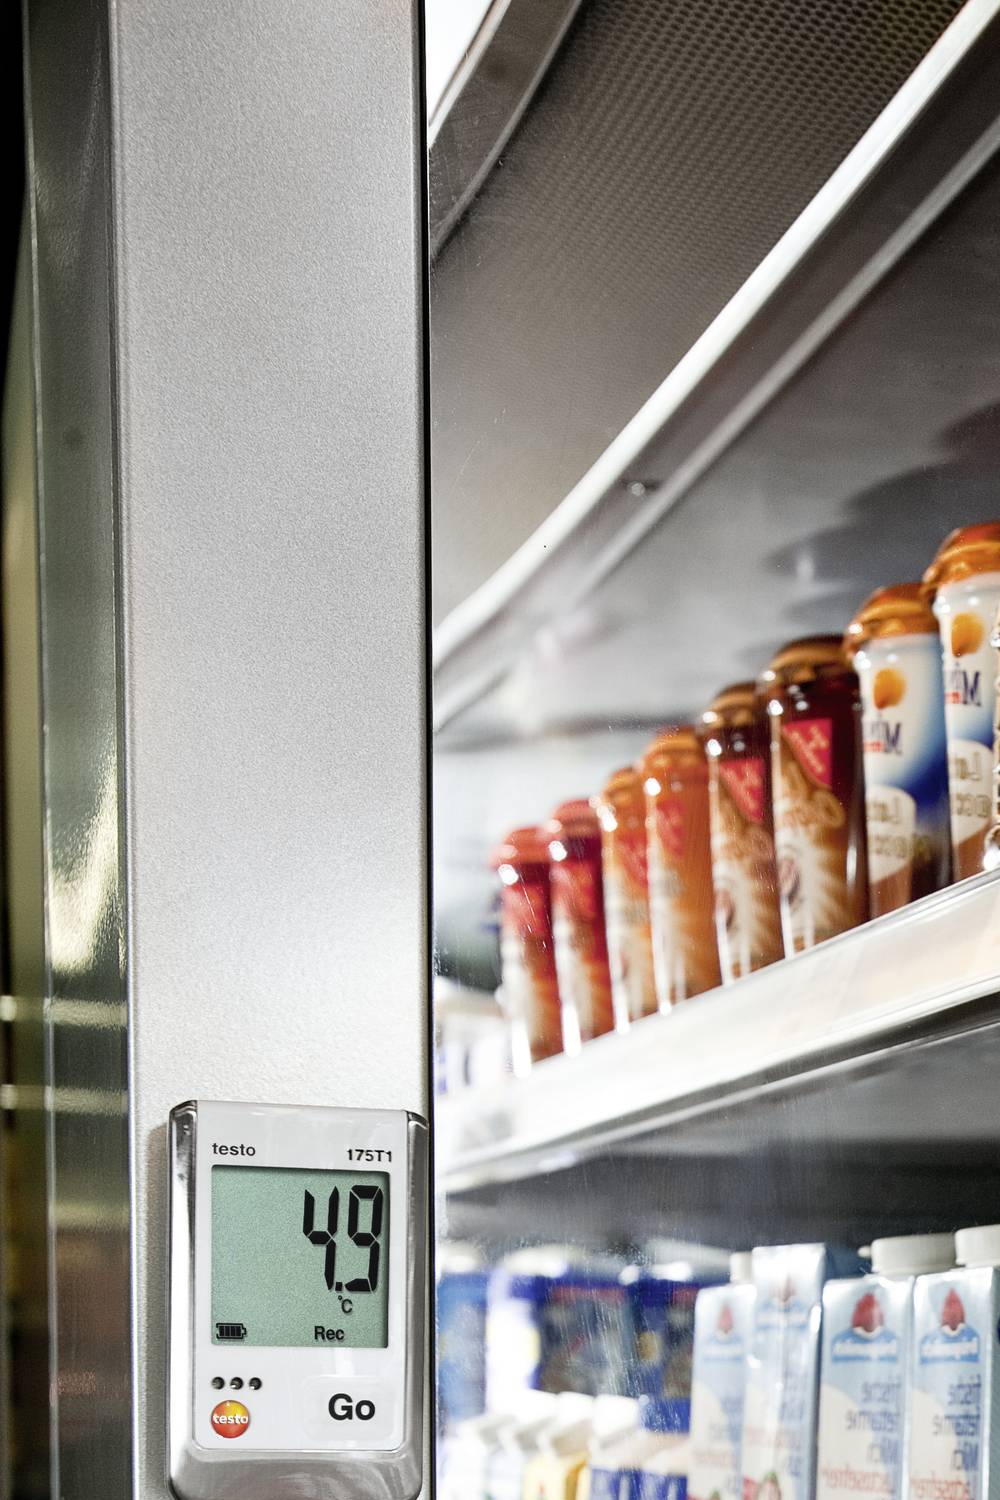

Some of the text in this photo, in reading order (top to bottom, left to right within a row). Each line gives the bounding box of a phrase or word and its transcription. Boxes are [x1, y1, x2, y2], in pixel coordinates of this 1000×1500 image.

[212, 1142, 256, 1157] testo
[346, 1148, 393, 1162] 175T1
[302, 1184, 384, 1293] 4.9
[314, 1325, 345, 1341] Rec
[328, 1393, 376, 1421] Go
[212, 1412, 249, 1425] testo
